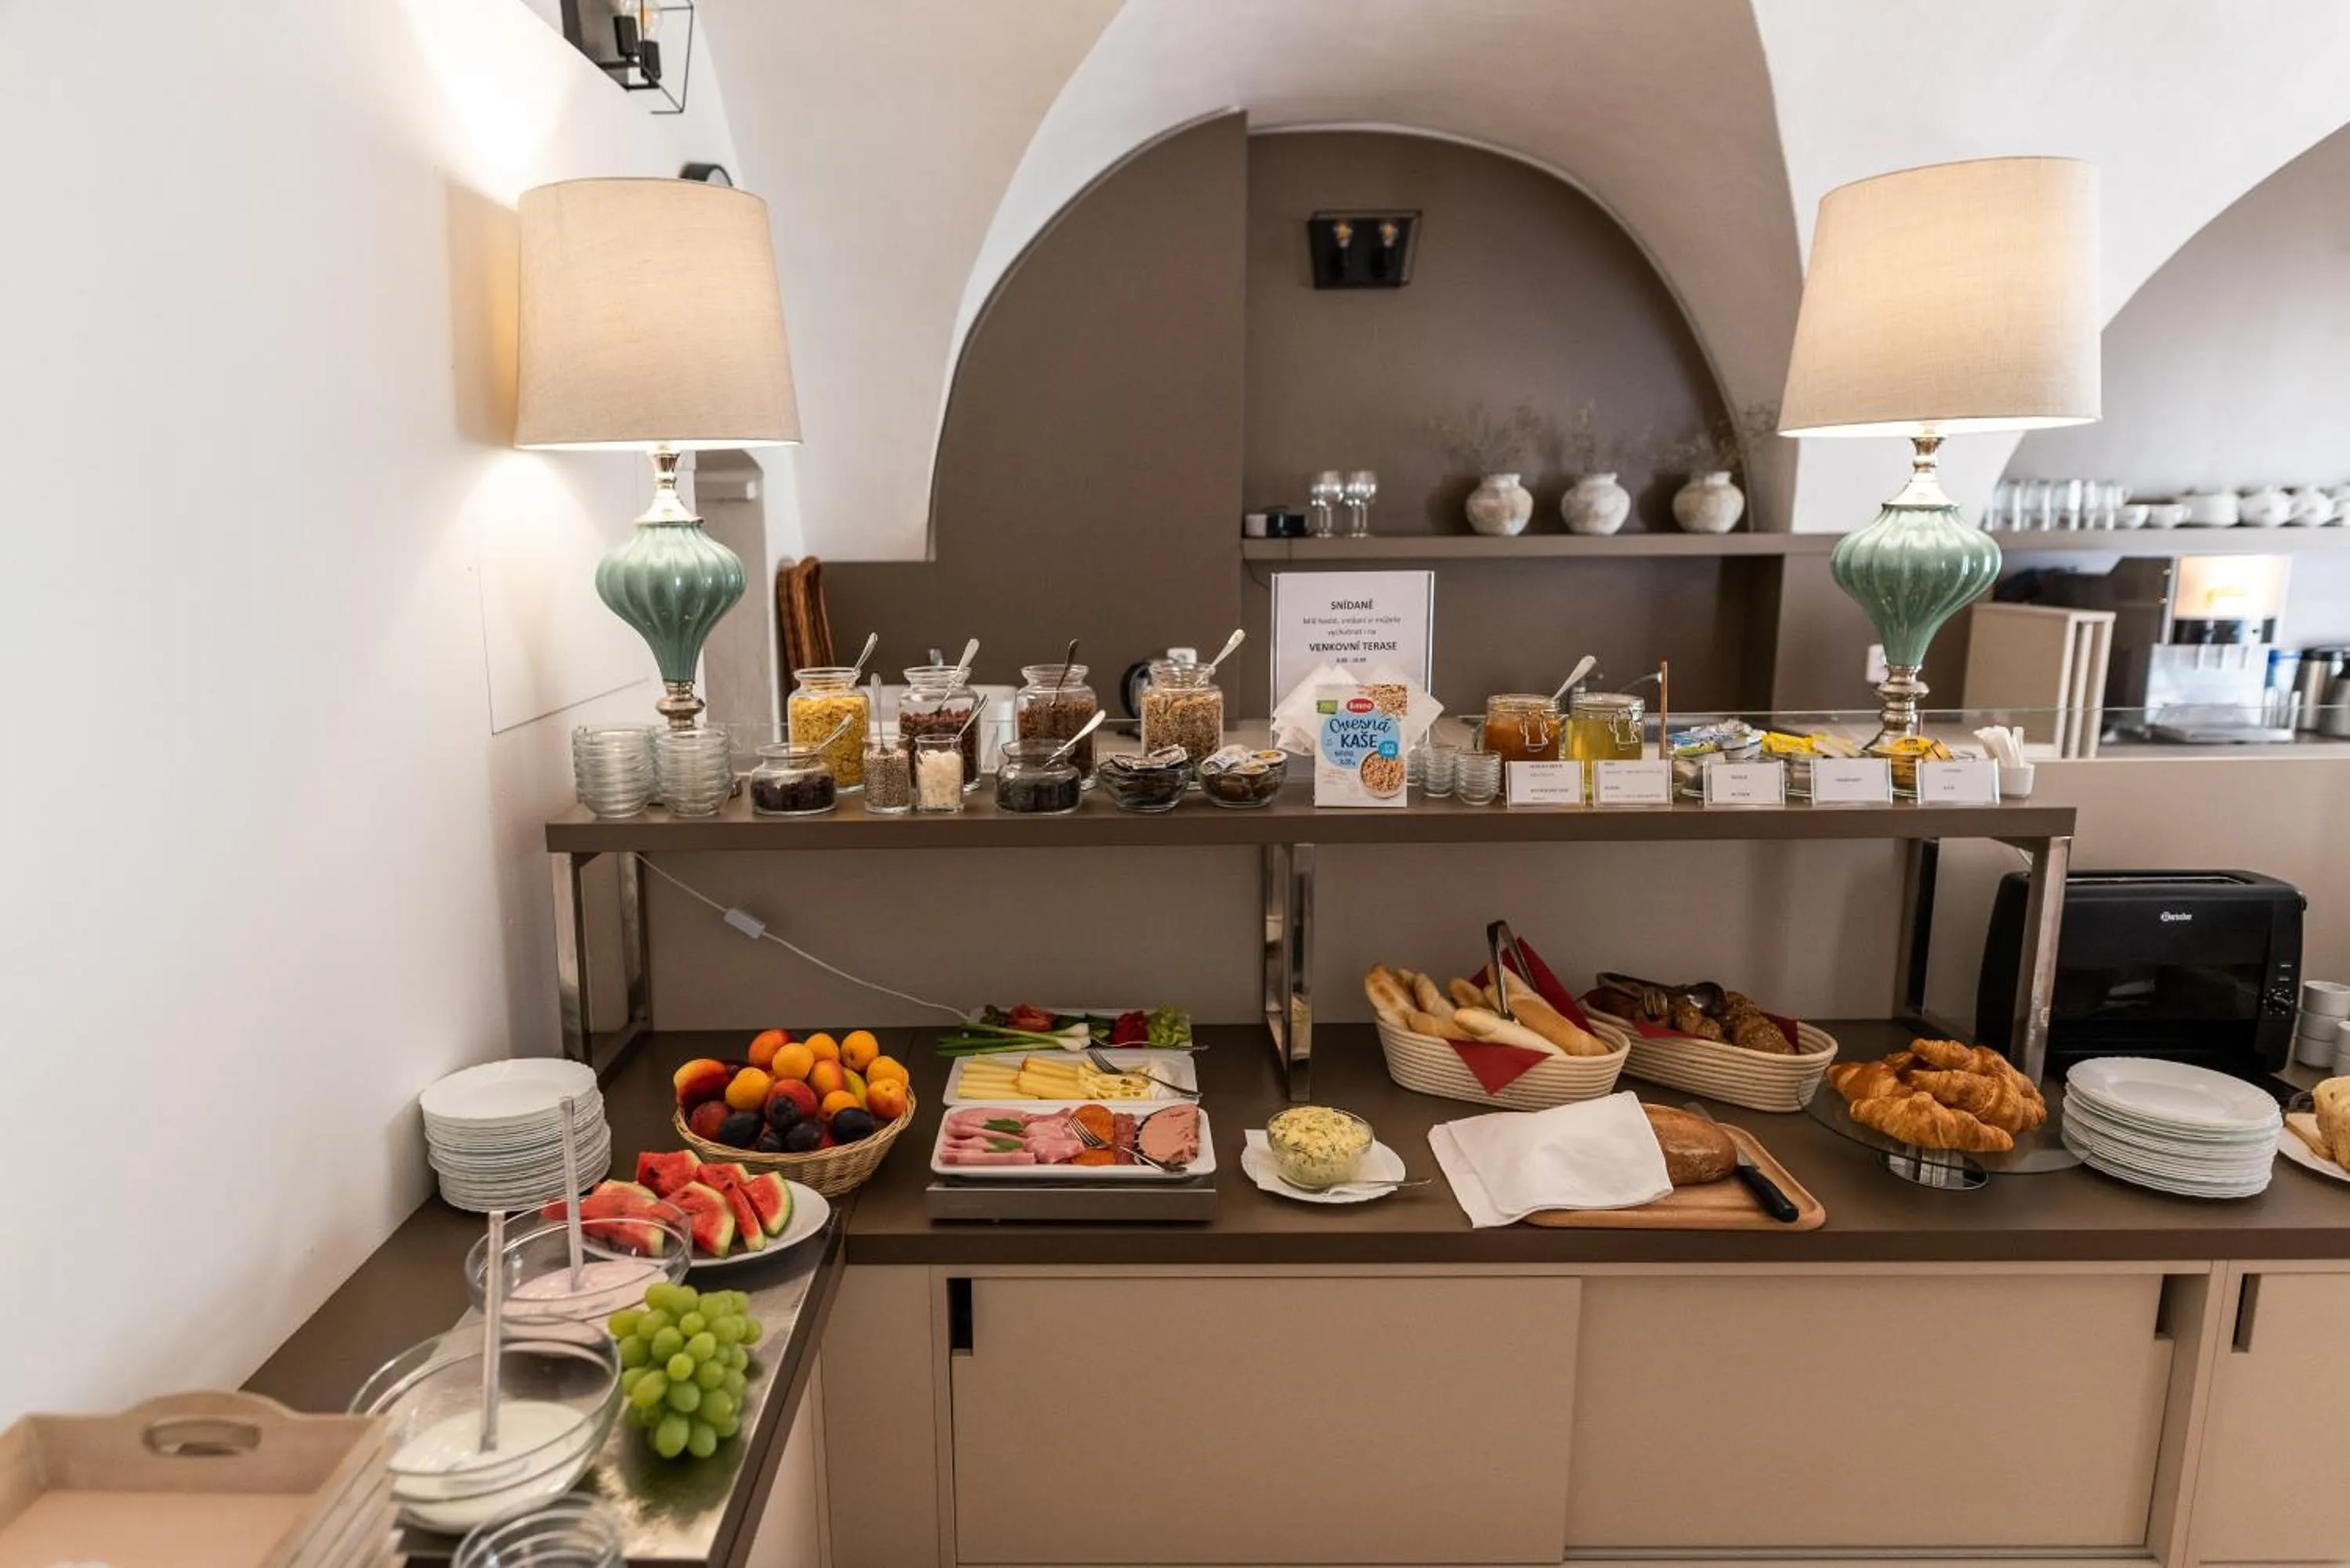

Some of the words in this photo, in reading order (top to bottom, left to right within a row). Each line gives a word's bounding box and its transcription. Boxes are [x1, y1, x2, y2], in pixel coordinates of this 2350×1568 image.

[1309, 640, 1361, 652] VENKOVNÍ
[1363, 641, 1397, 651] TERASE
[1329, 718, 1392, 734] Ovesná
[1340, 731, 1378, 748] KAŠE
